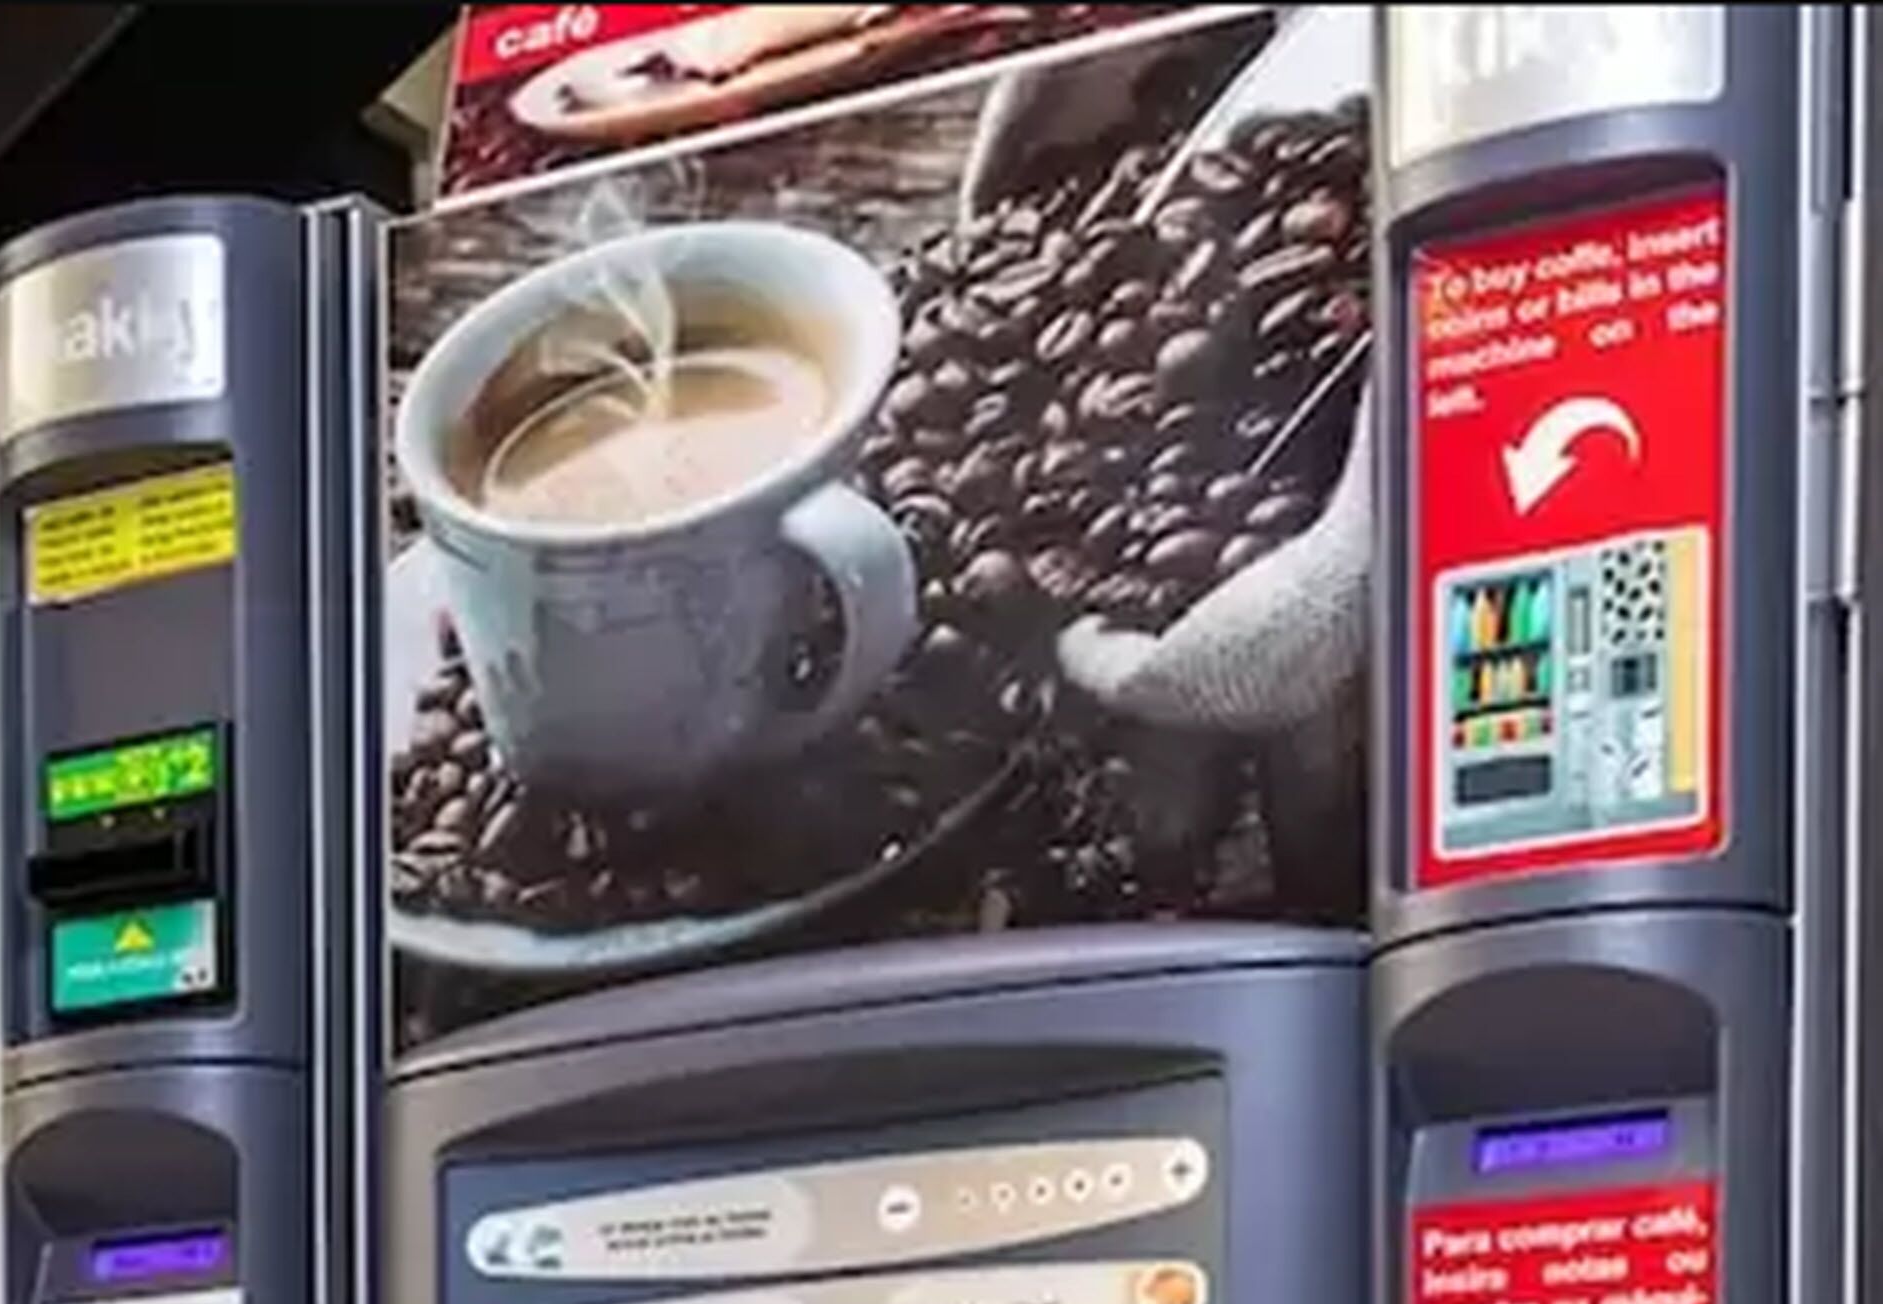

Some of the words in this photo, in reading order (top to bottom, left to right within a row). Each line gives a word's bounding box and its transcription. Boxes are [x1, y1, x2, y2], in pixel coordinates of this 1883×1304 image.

[1471, 262, 1529, 295] buy
[1627, 217, 1720, 262] insert
[1516, 296, 1552, 324] or
[1555, 279, 1624, 315] bills
[1629, 273, 1664, 300] in
[1667, 262, 1719, 291] the
[1426, 334, 1557, 382] machine
[1588, 318, 1635, 348] on
[1667, 301, 1719, 331] the
[1422, 1227, 1492, 1258] Para
[1497, 1217, 1628, 1254] comprar
[1631, 1204, 1709, 1241] café,
[1543, 1254, 1629, 1286] notas
[1666, 1248, 1709, 1276] ou
